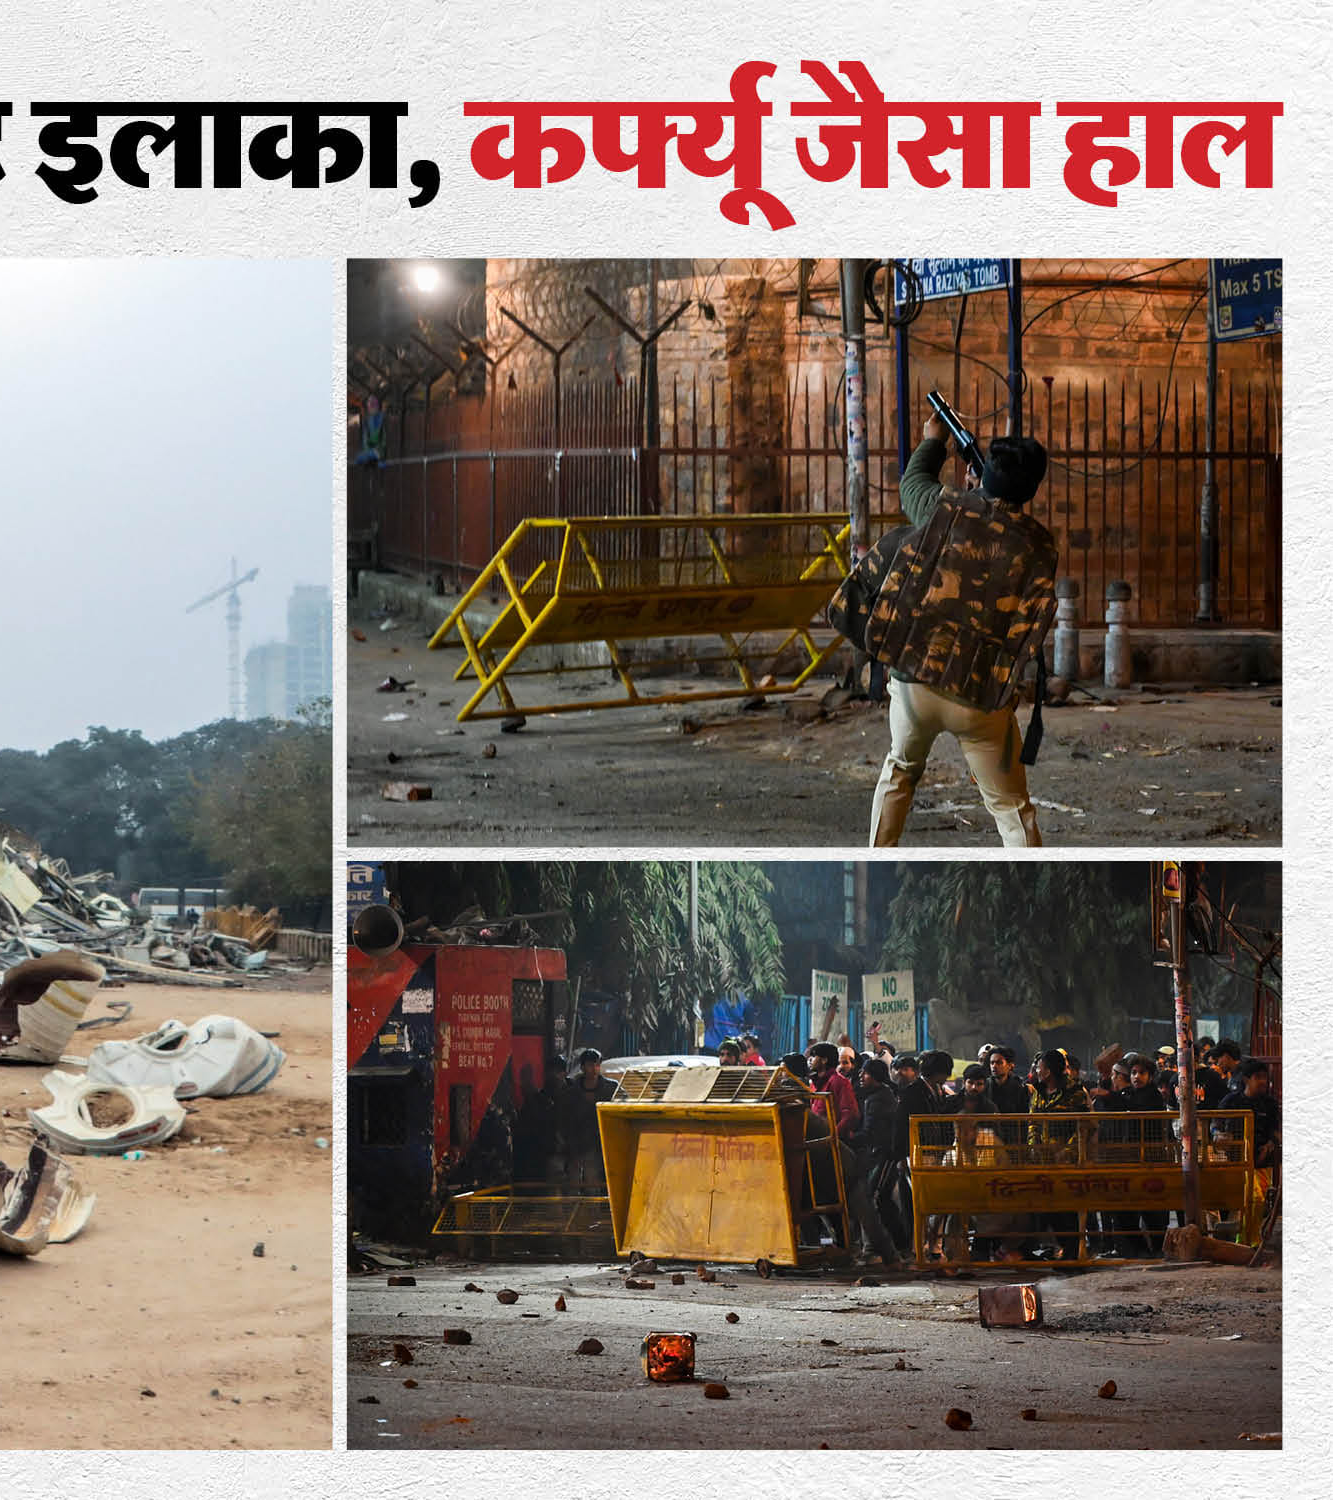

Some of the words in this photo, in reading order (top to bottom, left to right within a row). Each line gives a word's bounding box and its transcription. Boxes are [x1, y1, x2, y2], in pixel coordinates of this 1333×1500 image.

[974, 264, 1000, 287] TOMB
[1220, 278, 1249, 299] Max
[1252, 272, 1261, 293] 5
[882, 975, 897, 997] NO
[452, 995, 481, 1010] POLICE
[484, 995, 509, 1010] BOOTH
[871, 1000, 909, 1014] PARKING
[459, 1055, 474, 1067] BEAT
